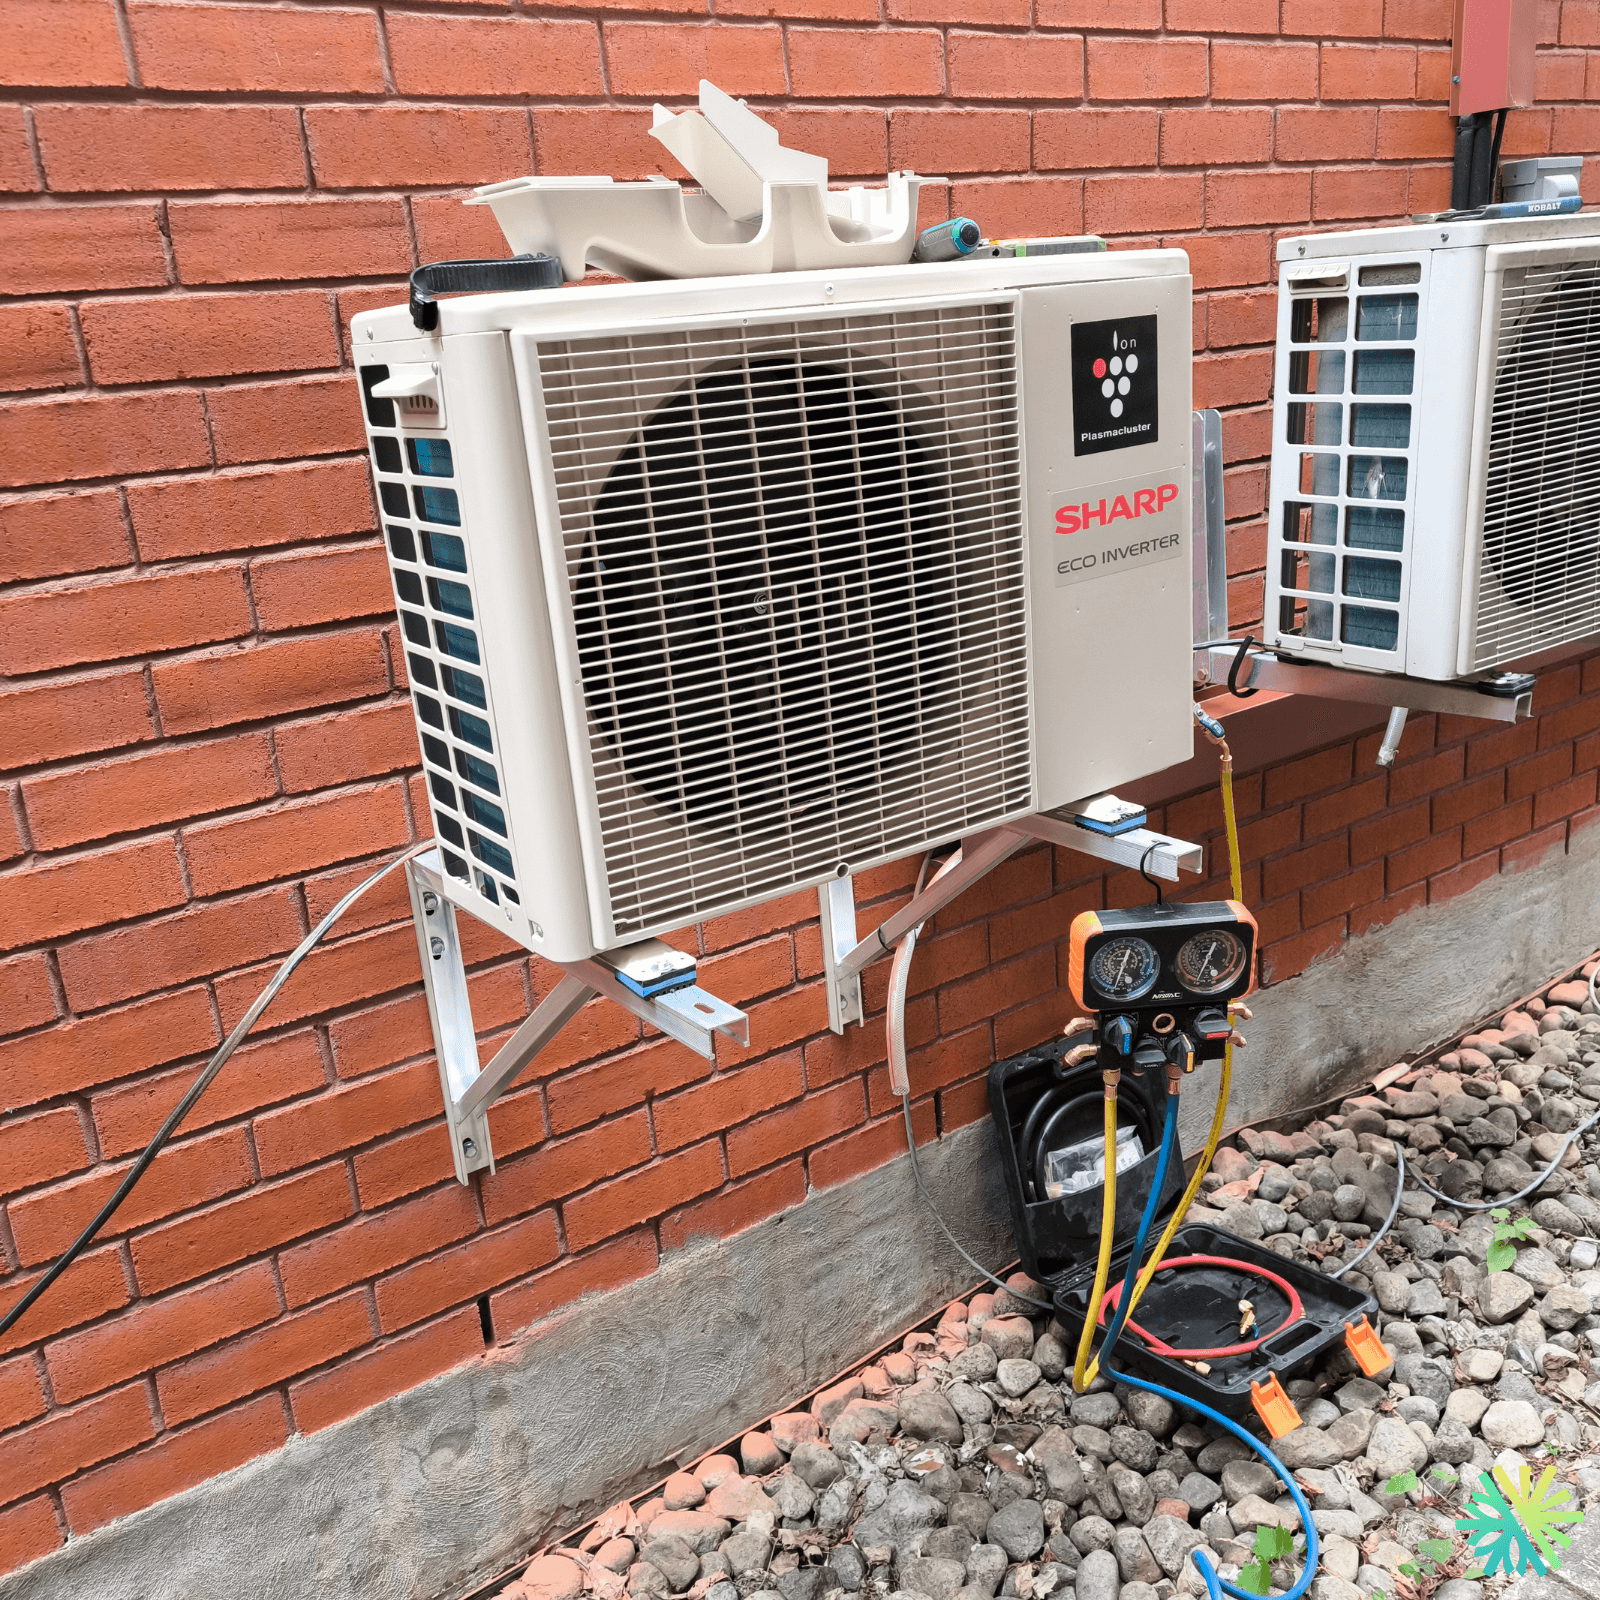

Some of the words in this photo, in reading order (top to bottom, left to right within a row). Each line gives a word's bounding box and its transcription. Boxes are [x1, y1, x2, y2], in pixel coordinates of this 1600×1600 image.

[1528, 202, 1561, 212] KOBALT
[1081, 423, 1151, 442] Plasmacluster
[1055, 483, 1179, 534] SHARP
[1057, 555, 1097, 574] ECO
[1102, 533, 1180, 564] INVERTER
